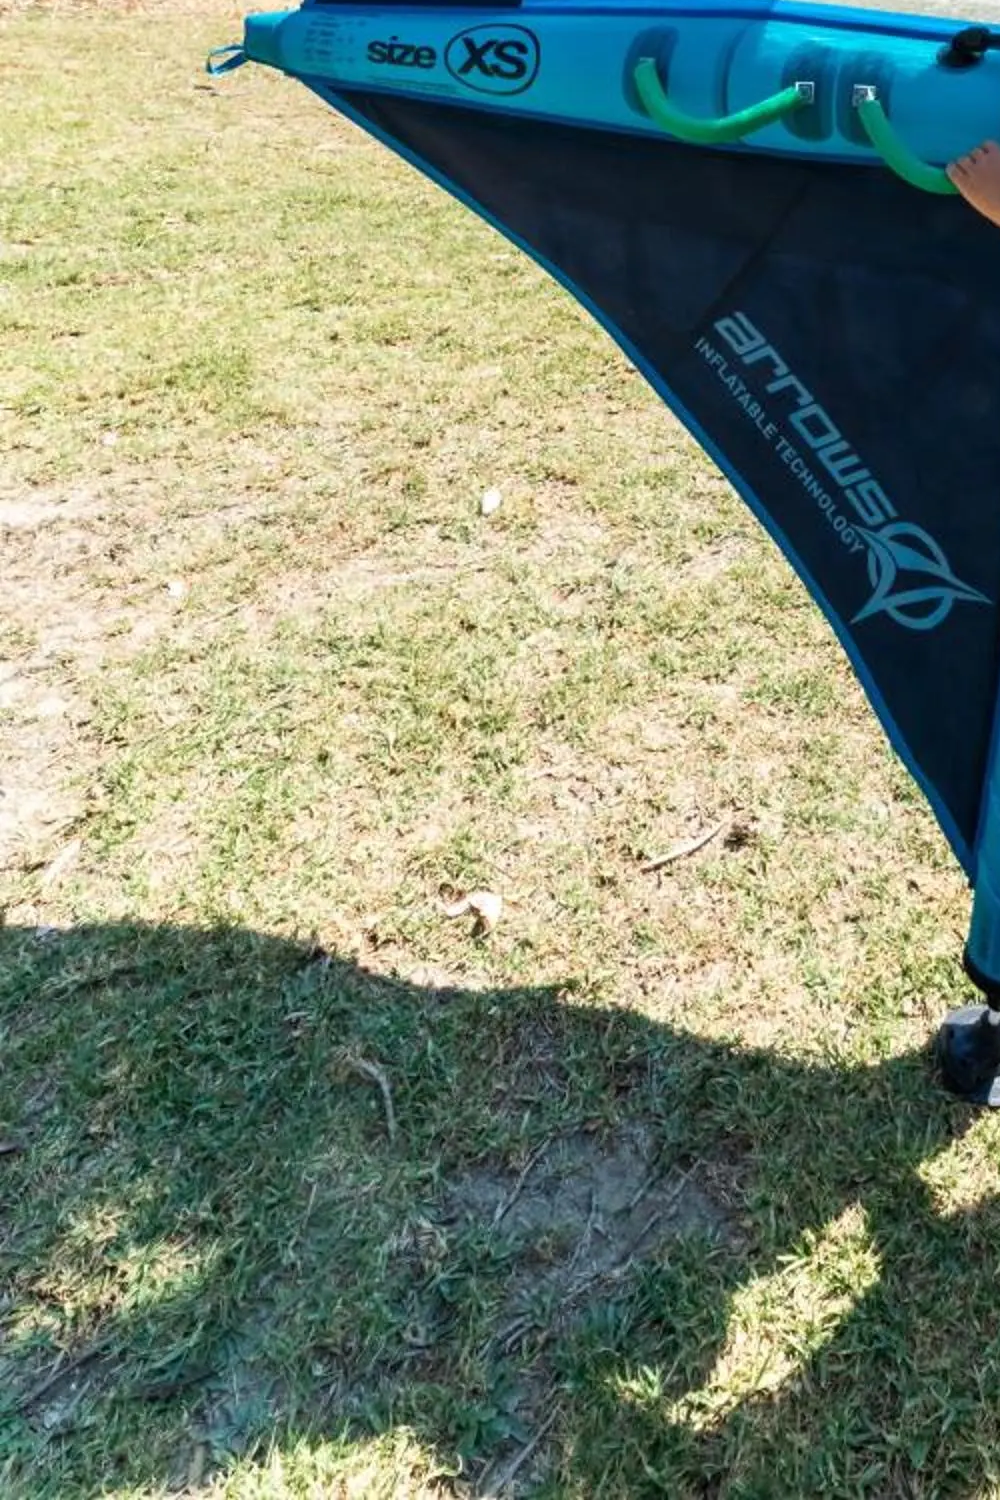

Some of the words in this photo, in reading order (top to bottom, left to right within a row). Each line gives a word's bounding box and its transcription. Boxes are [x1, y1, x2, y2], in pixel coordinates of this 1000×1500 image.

[367, 36, 437, 69] size
[458, 37, 529, 80] XS
[694, 338, 778, 440] INFLATABLE
[776, 433, 866, 553] TECHNOLOGY
[714, 311, 899, 526] arrows
